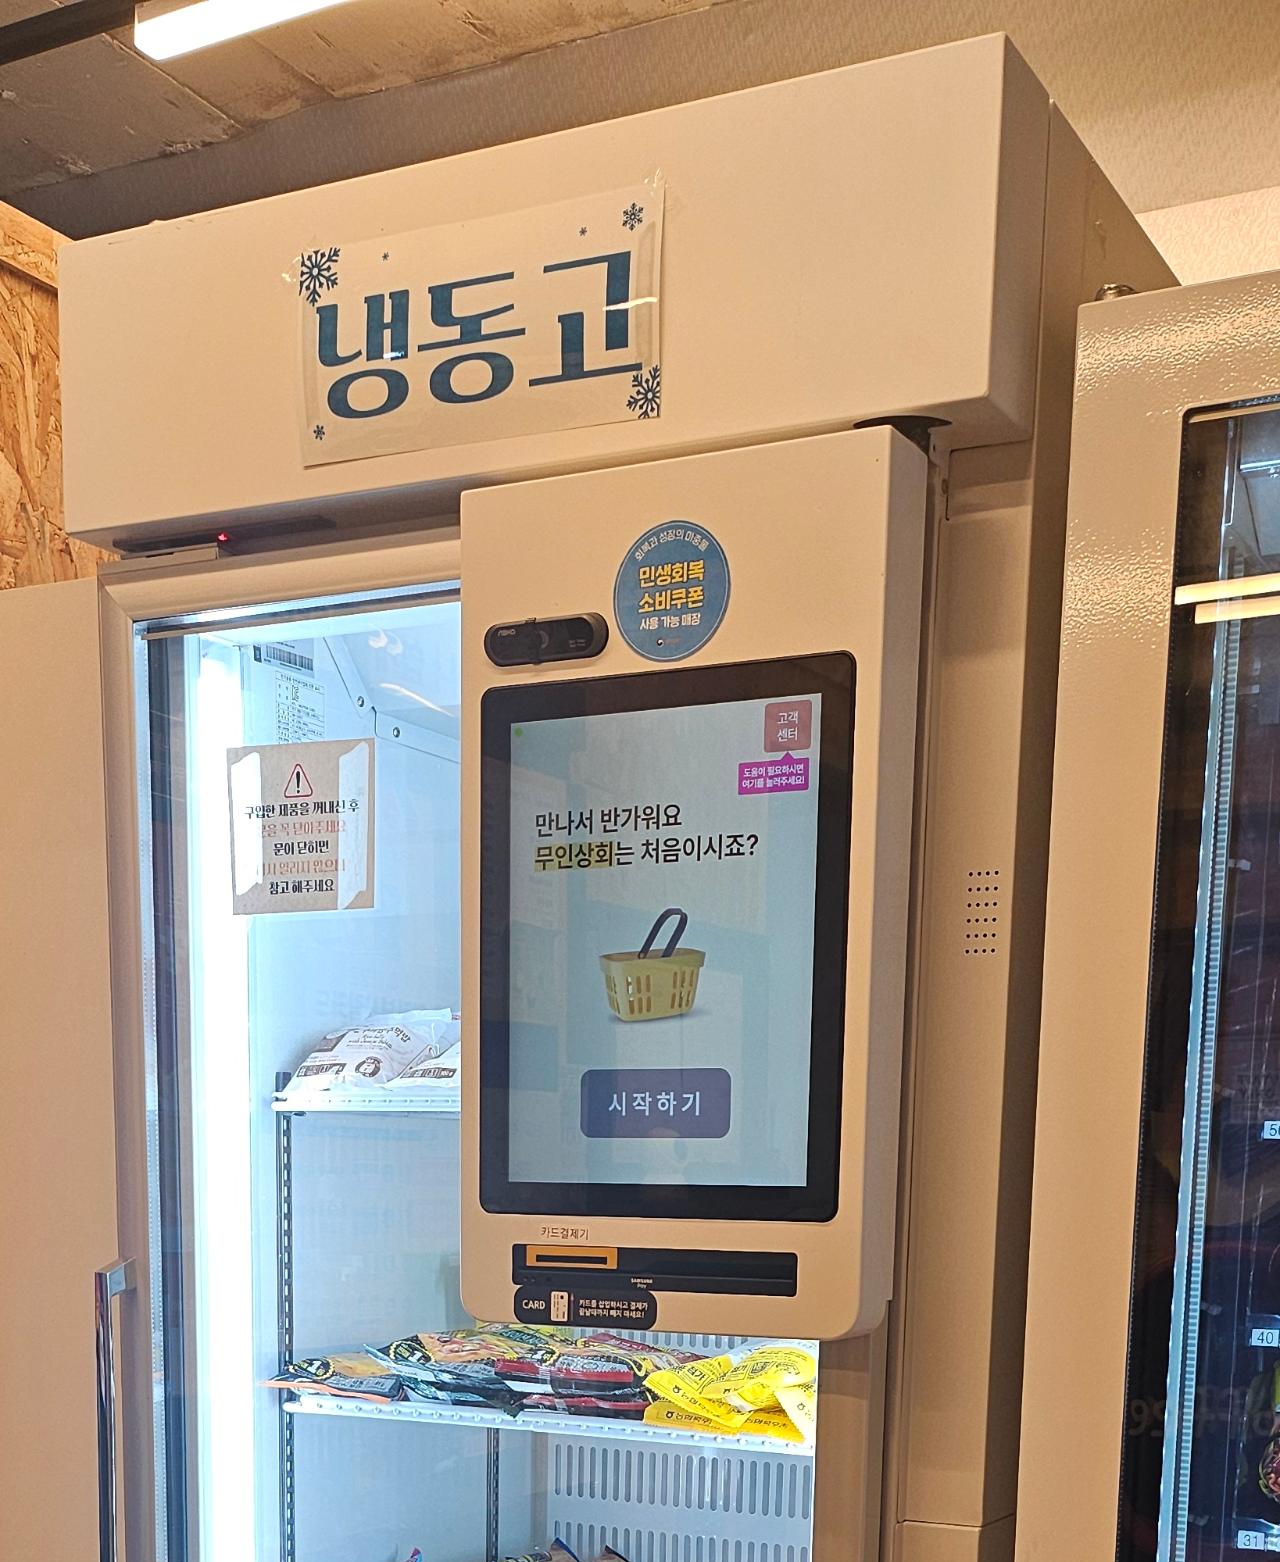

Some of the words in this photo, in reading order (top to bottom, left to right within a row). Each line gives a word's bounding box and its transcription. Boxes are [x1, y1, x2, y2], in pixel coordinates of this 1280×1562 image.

[316, 250, 642, 420] 냉동고
[635, 538, 658, 561] 회복과
[659, 529, 685, 543] 성장의
[639, 559, 705, 588] 민생회복
[638, 585, 704, 613] 소비쿠폰
[639, 616, 659, 630] 사용
[660, 615, 680, 628] 가능
[681, 612, 701, 626] 매장
[777, 710, 799, 724] 고객
[777, 727, 798, 742] 센터
[743, 767, 766, 778] 도움이
[767, 763, 804, 776] 필요하시면
[742, 778, 764, 789] 여기를
[244, 804, 275, 819] 구입한
[278, 801, 311, 817] 제품을
[312, 800, 346, 815] 꺼내신
[348, 798, 360, 813] 후
[535, 809, 593, 838] 만나서
[600, 803, 682, 834] 반가워요
[273, 842, 295, 856] 문이
[297, 840, 329, 855] 닫히면
[534, 840, 635, 871] 무인상회는
[640, 833, 759, 864] 처음이시죠?
[269, 880, 290, 895] 참고
[291, 878, 335, 894] 해주세요
[608, 1091, 702, 1117] 시작하기
[1269, 1122, 1280, 1137] 5
[540, 1226, 589, 1240] 카드결제기
[522, 1300, 546, 1310] CARD
[579, 1299, 597, 1308] 카드를
[598, 1300, 629, 1309] 삽입하시고
[630, 1301, 648, 1311] 결제가
[623, 1310, 645, 1319] 마세요!
[1256, 1331, 1275, 1345] 40
[1242, 1533, 1259, 1548] 31
